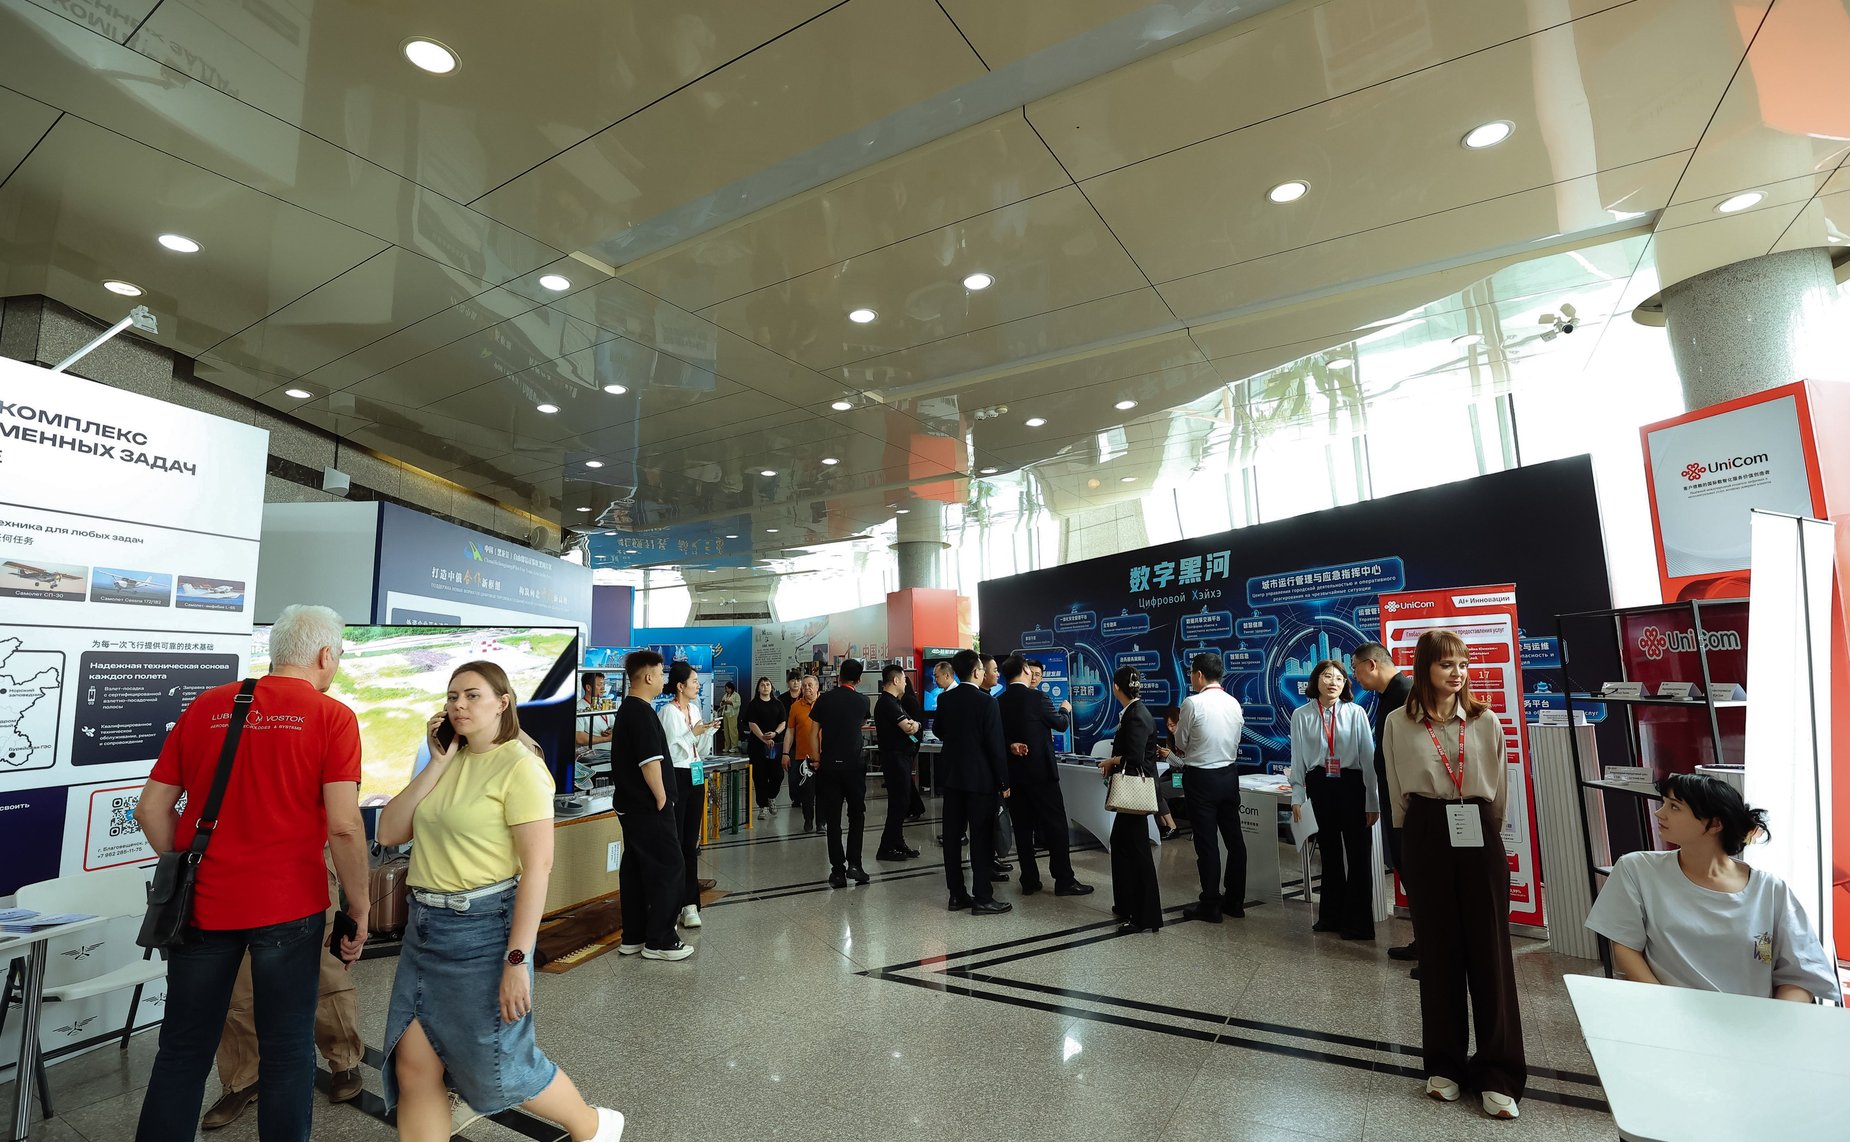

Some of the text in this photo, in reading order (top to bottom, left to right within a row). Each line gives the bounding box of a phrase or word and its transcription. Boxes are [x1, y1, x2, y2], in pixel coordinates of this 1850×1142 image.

[0, 400, 148, 446] КОМПЛЕКС
[119, 448, 197, 476] ЗАДАЧ
[1708, 453, 1769, 474] UniCom
[44, 525, 69, 536] для
[71, 528, 110, 541] любых
[112, 534, 144, 545] задач
[1129, 550, 1231, 593] 数字黑河
[1261, 564, 1382, 590] 城市运行管理与应急指挥中心
[1265, 589, 1291, 597] управления
[1291, 585, 1316, 594] городской
[1316, 581, 1353, 591] деятельностью
[1358, 575, 1396, 585] оперативного
[1312, 589, 1346, 597] чрезвычайные
[1347, 585, 1372, 593] ситуации
[1138, 588, 1222, 609] Цифровой Хэйхэ
[1470, 596, 1510, 604] Инновации
[1400, 601, 1435, 610] UniCom
[92, 639, 214, 651] 为每一次飞行提供可靠的技术基础
[90, 662, 140, 670] Надежная
[1478, 670, 1490, 679] 17
[1071, 685, 1095, 697] 字政府
[1480, 694, 1492, 703] 18
[266, 715, 305, 723] VOSTOK
